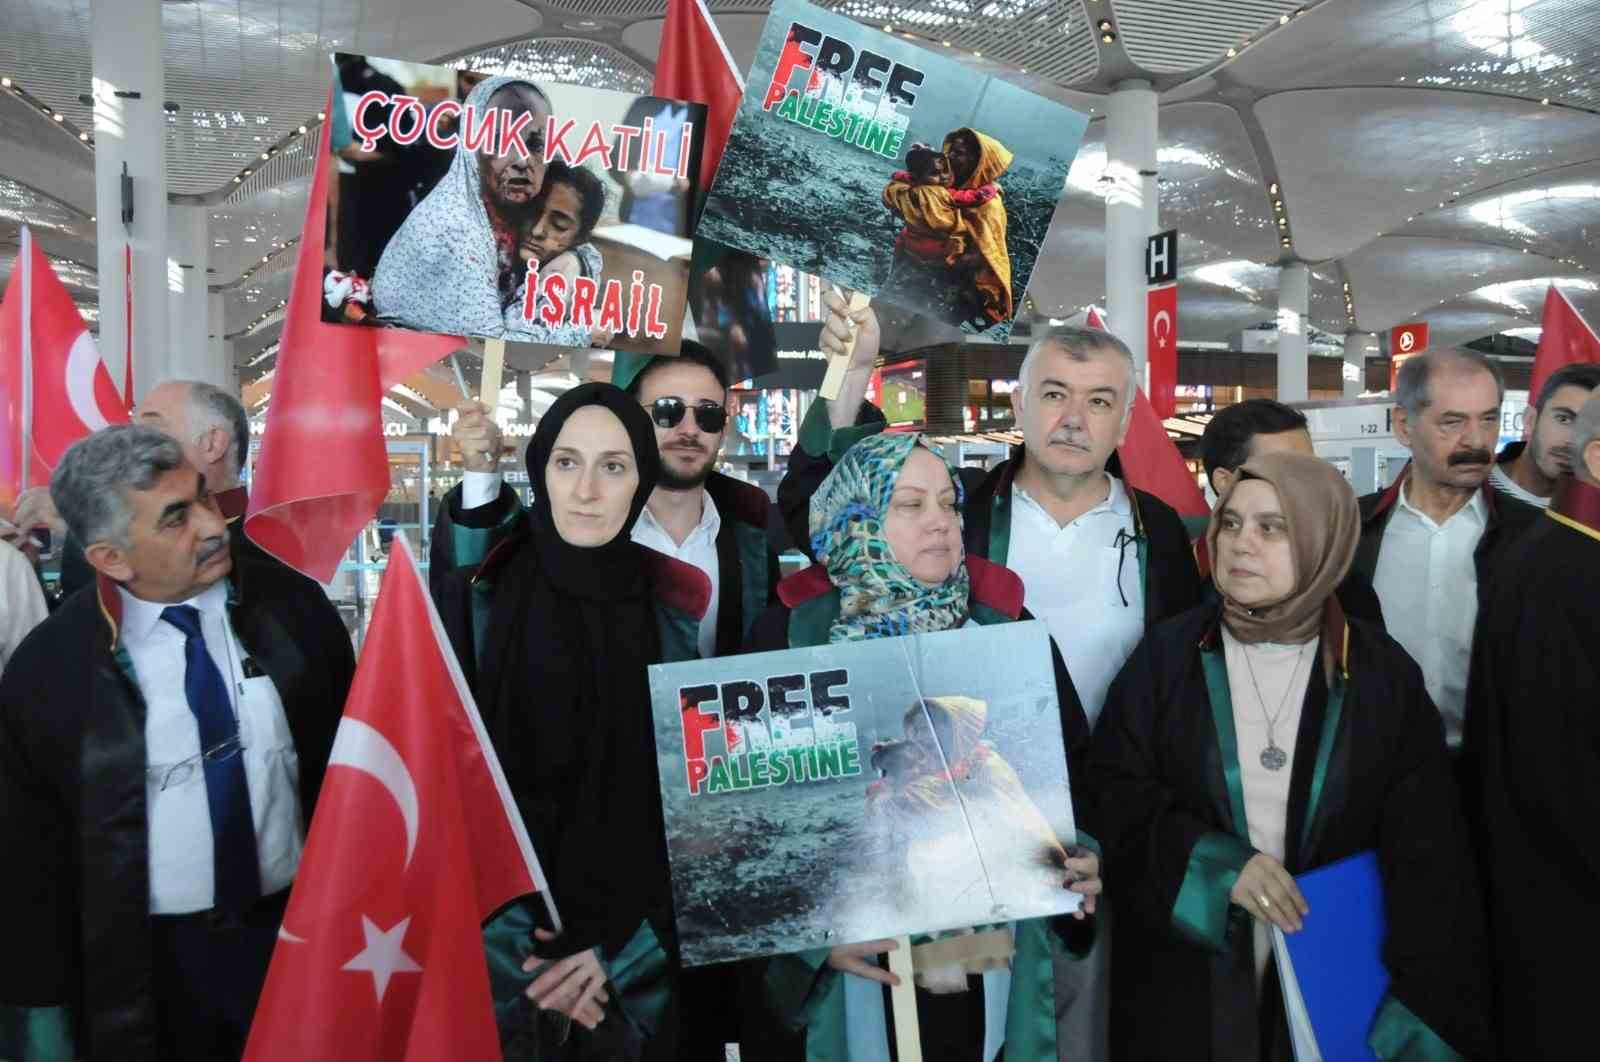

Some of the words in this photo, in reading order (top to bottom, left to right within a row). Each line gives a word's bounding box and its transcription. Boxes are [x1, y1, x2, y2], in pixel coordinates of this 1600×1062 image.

[770, 22, 925, 131] FREE
[353, 90, 533, 159] ÇOCUK
[543, 115, 693, 179] KATİLİ
[763, 82, 905, 159] PALESTINE
[1150, 237, 1168, 278] H
[522, 257, 667, 339] İSRAİL
[776, 350, 806, 359] stanbul
[679, 668, 858, 760] FREE
[687, 740, 861, 796] PALESTINE
